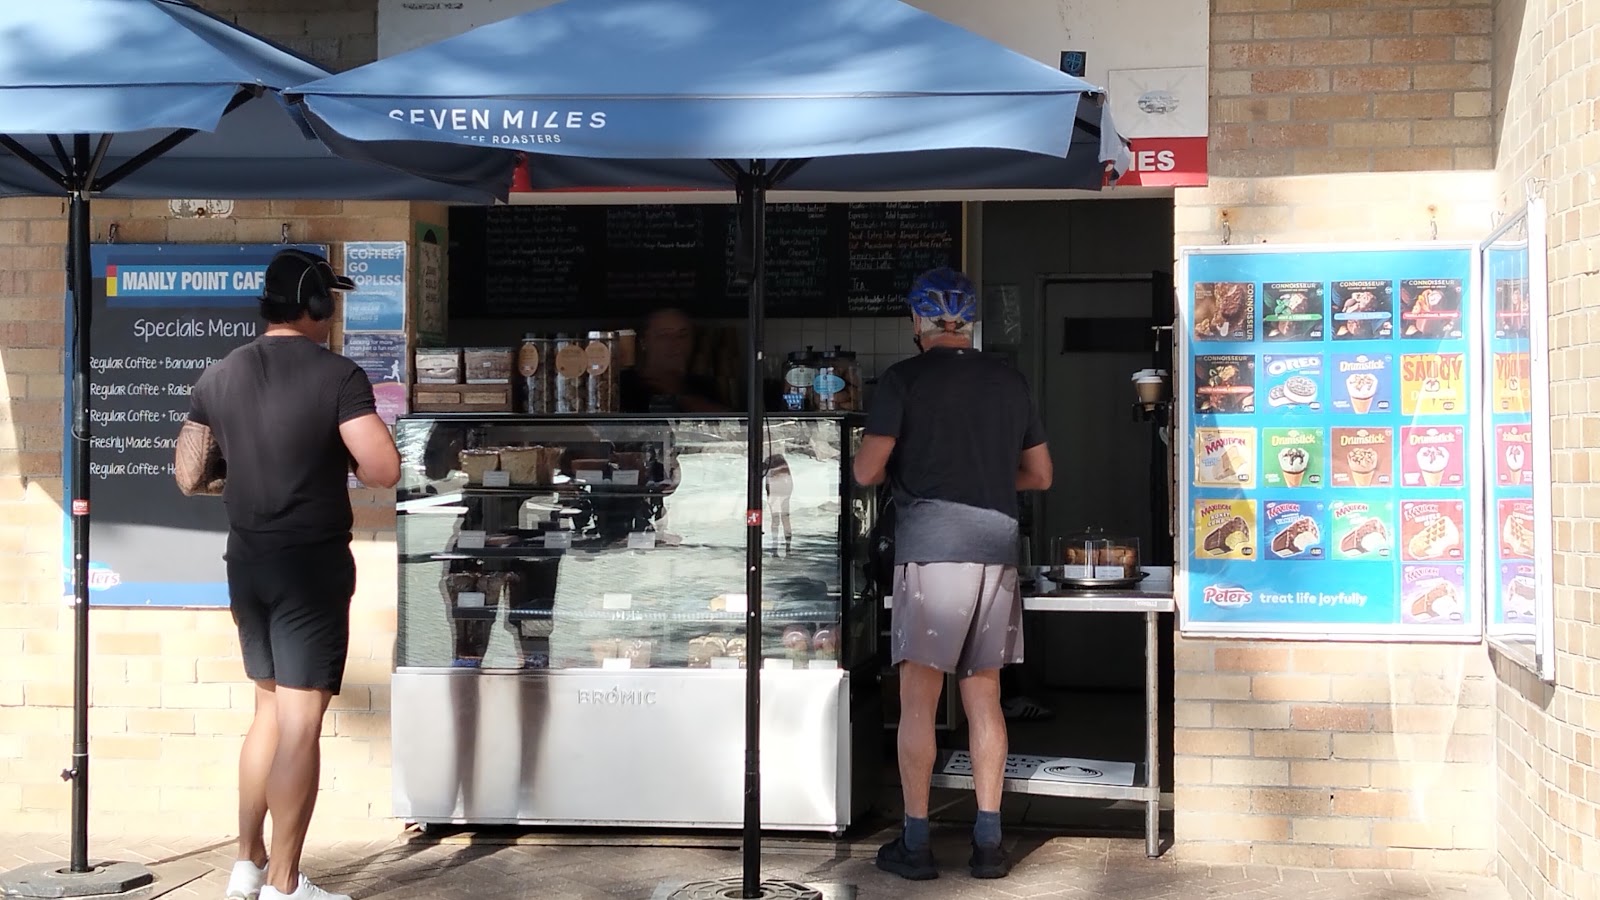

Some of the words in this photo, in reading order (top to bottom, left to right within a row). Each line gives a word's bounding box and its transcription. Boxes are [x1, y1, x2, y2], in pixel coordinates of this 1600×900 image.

[503, 110, 606, 129] MILES
[492, 134, 561, 144] ROASTERS
[348, 248, 401, 260] COFFEE?
[348, 262, 368, 272] GO
[122, 271, 176, 290] MANLY
[182, 272, 228, 290] POINT
[232, 272, 265, 290] CAF
[134, 318, 204, 342] Specials
[208, 318, 256, 337] Menu
[125, 356, 157, 369] Coffee
[166, 357, 204, 369] Banana
[1268, 356, 1321, 376] OREO
[1340, 360, 1384, 372] Drumstick
[1403, 360, 1462, 381] SAUCY
[90, 383, 126, 400] Regular
[128, 383, 160, 396] Coffee
[90, 410, 126, 427] Regular
[128, 410, 160, 422] Coffee
[126, 437, 151, 448] Made
[1272, 434, 1316, 446] Drumstick
[1340, 434, 1386, 446] Drumstick
[1410, 432, 1456, 446] Drumstick
[90, 462, 125, 480] Regular
[127, 463, 160, 475] Coffee
[1204, 587, 1252, 604] Peters
[1260, 592, 1293, 604] treat
[1296, 592, 1316, 604] life
[1318, 592, 1368, 606] joyfully
